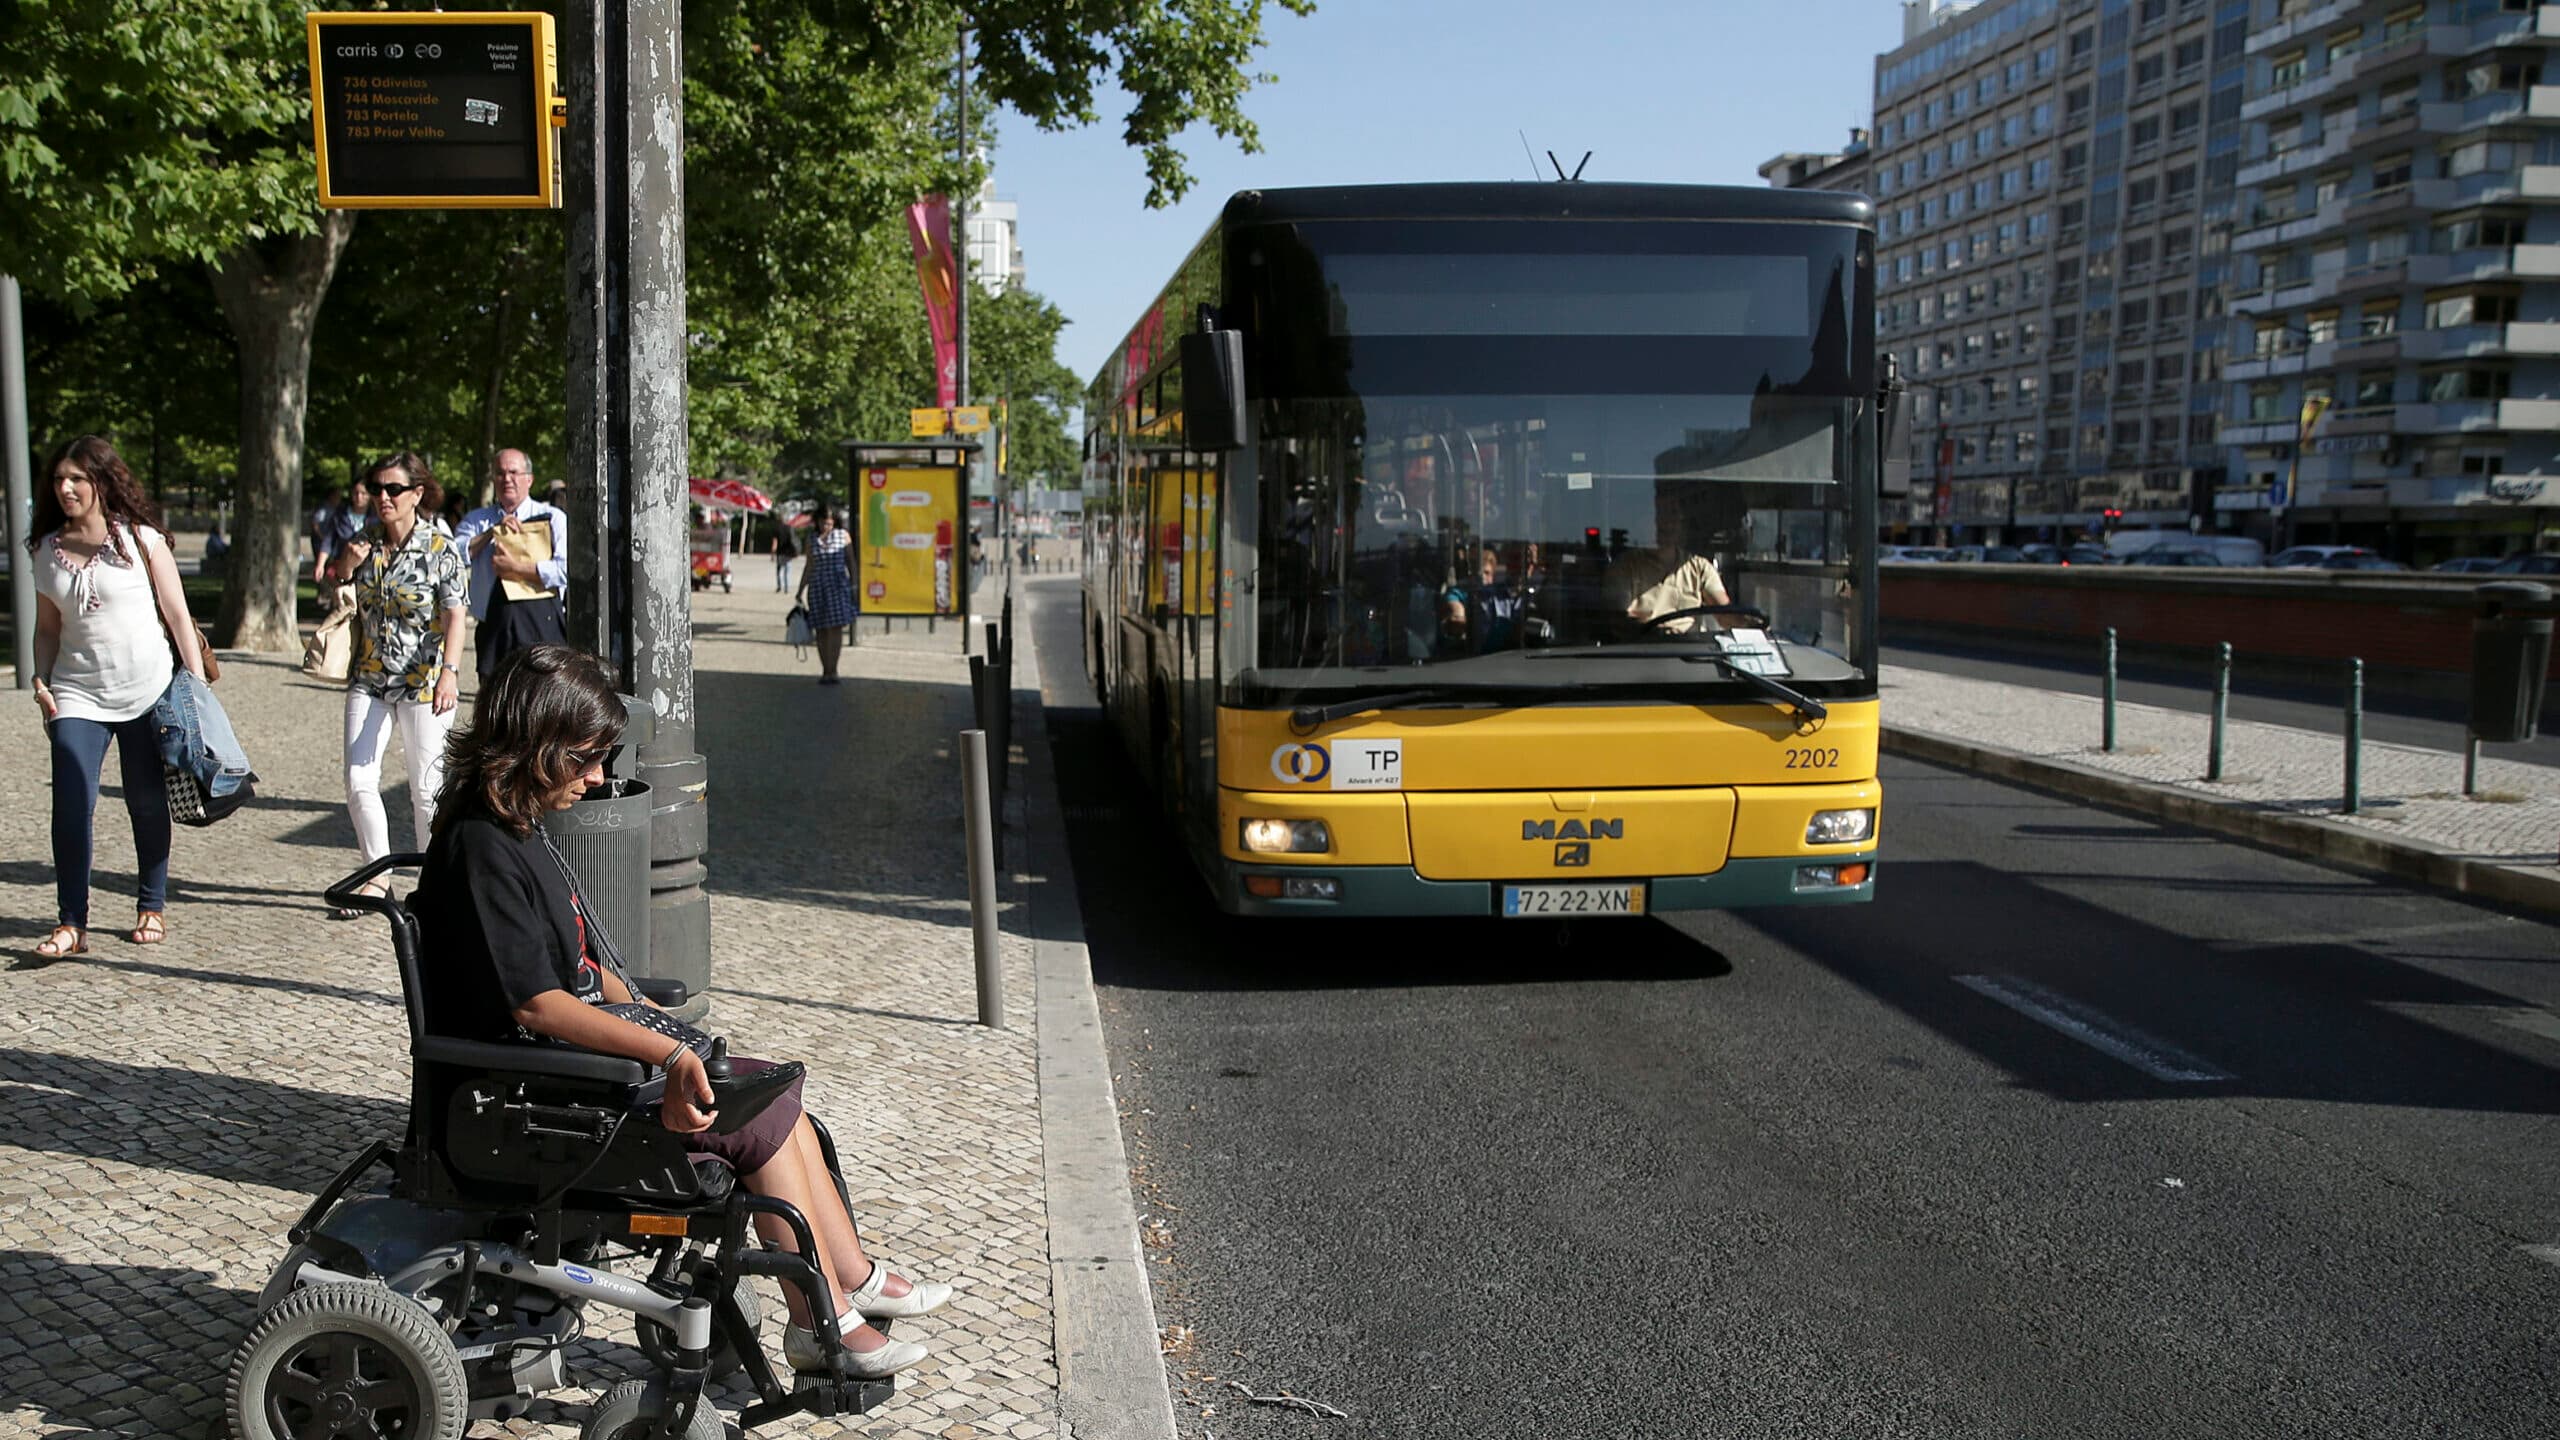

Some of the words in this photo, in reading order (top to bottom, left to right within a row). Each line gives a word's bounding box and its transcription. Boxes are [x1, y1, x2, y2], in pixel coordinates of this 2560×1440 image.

[336, 42, 378, 57] carris
[343, 76, 368, 89] 736
[371, 75, 428, 89] Odivelas
[343, 92, 369, 105] 744
[372, 92, 440, 105] Moscavide
[345, 109, 369, 121] 783
[373, 108, 419, 121] Portela
[346, 125, 370, 138] 783
[374, 125, 405, 138] Prior
[409, 125, 446, 138] Velho
[1365, 750, 1399, 771] TP
[1785, 748, 1839, 769] 2202
[1385, 776, 1399, 784] 427
[1522, 817, 1624, 841] MAN
[595, 1277, 638, 1297] Stream
